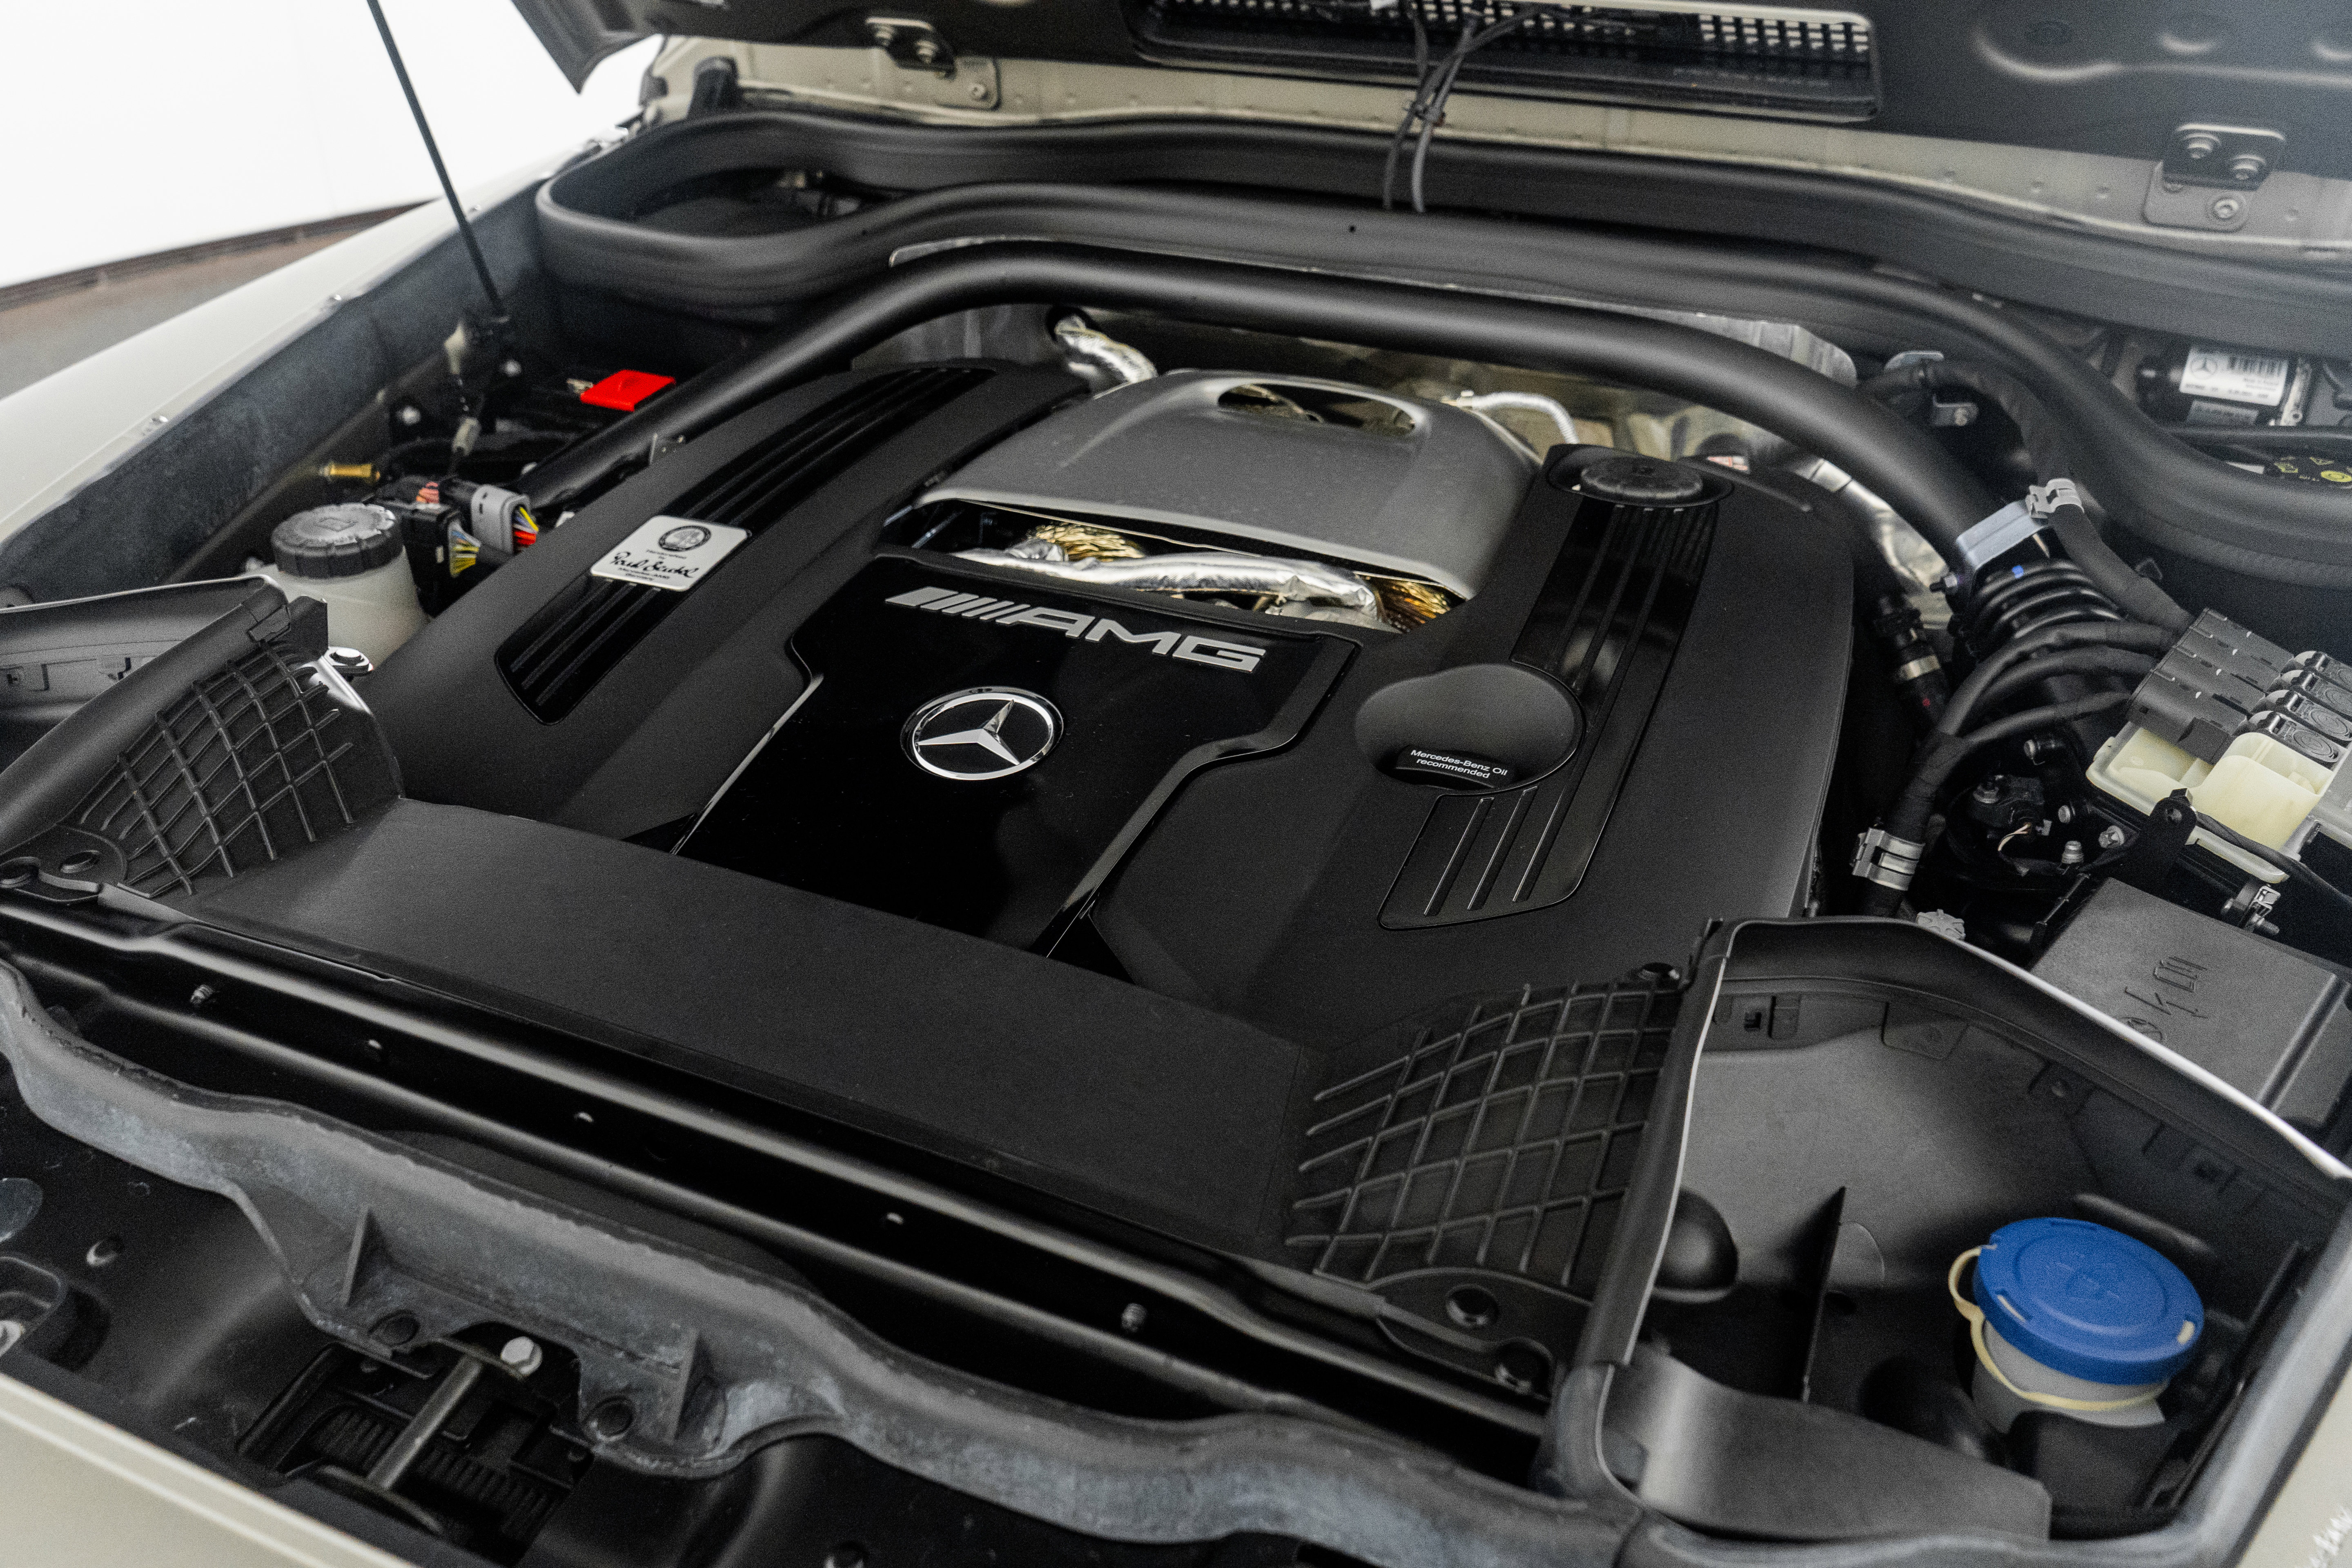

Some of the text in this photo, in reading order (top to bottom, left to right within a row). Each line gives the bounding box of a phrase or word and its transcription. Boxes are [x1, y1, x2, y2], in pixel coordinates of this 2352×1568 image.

[996, 606, 1266, 673] AMG
[1410, 749, 1508, 776] Mercedes-Benz Oil
[1416, 758, 1490, 779] recommended
